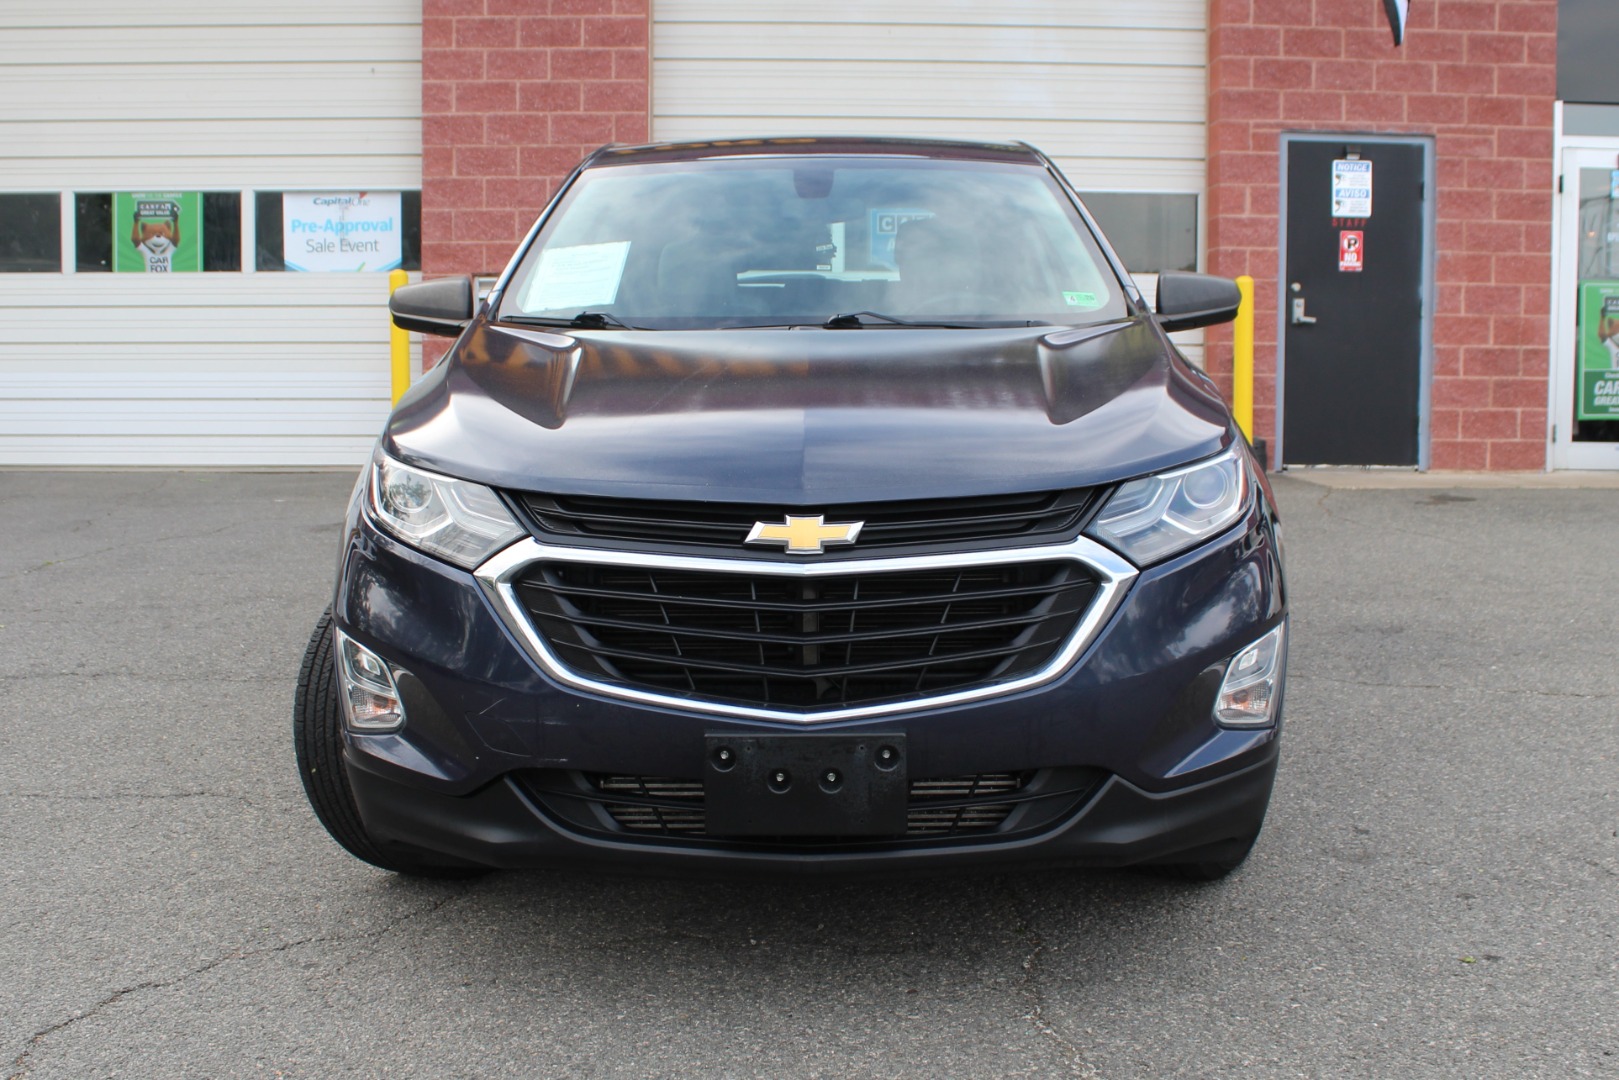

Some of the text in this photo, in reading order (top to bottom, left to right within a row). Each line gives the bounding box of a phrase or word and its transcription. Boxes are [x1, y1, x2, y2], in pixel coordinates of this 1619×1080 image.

[1337, 163, 1368, 171] NOTICE
[1338, 189, 1367, 198] AVISO
[291, 217, 393, 236] Pre-Approval
[1332, 218, 1367, 227] STAFF
[305, 239, 379, 253] Sale Event
[149, 256, 169, 264] CAR
[1344, 252, 1358, 262] NO
